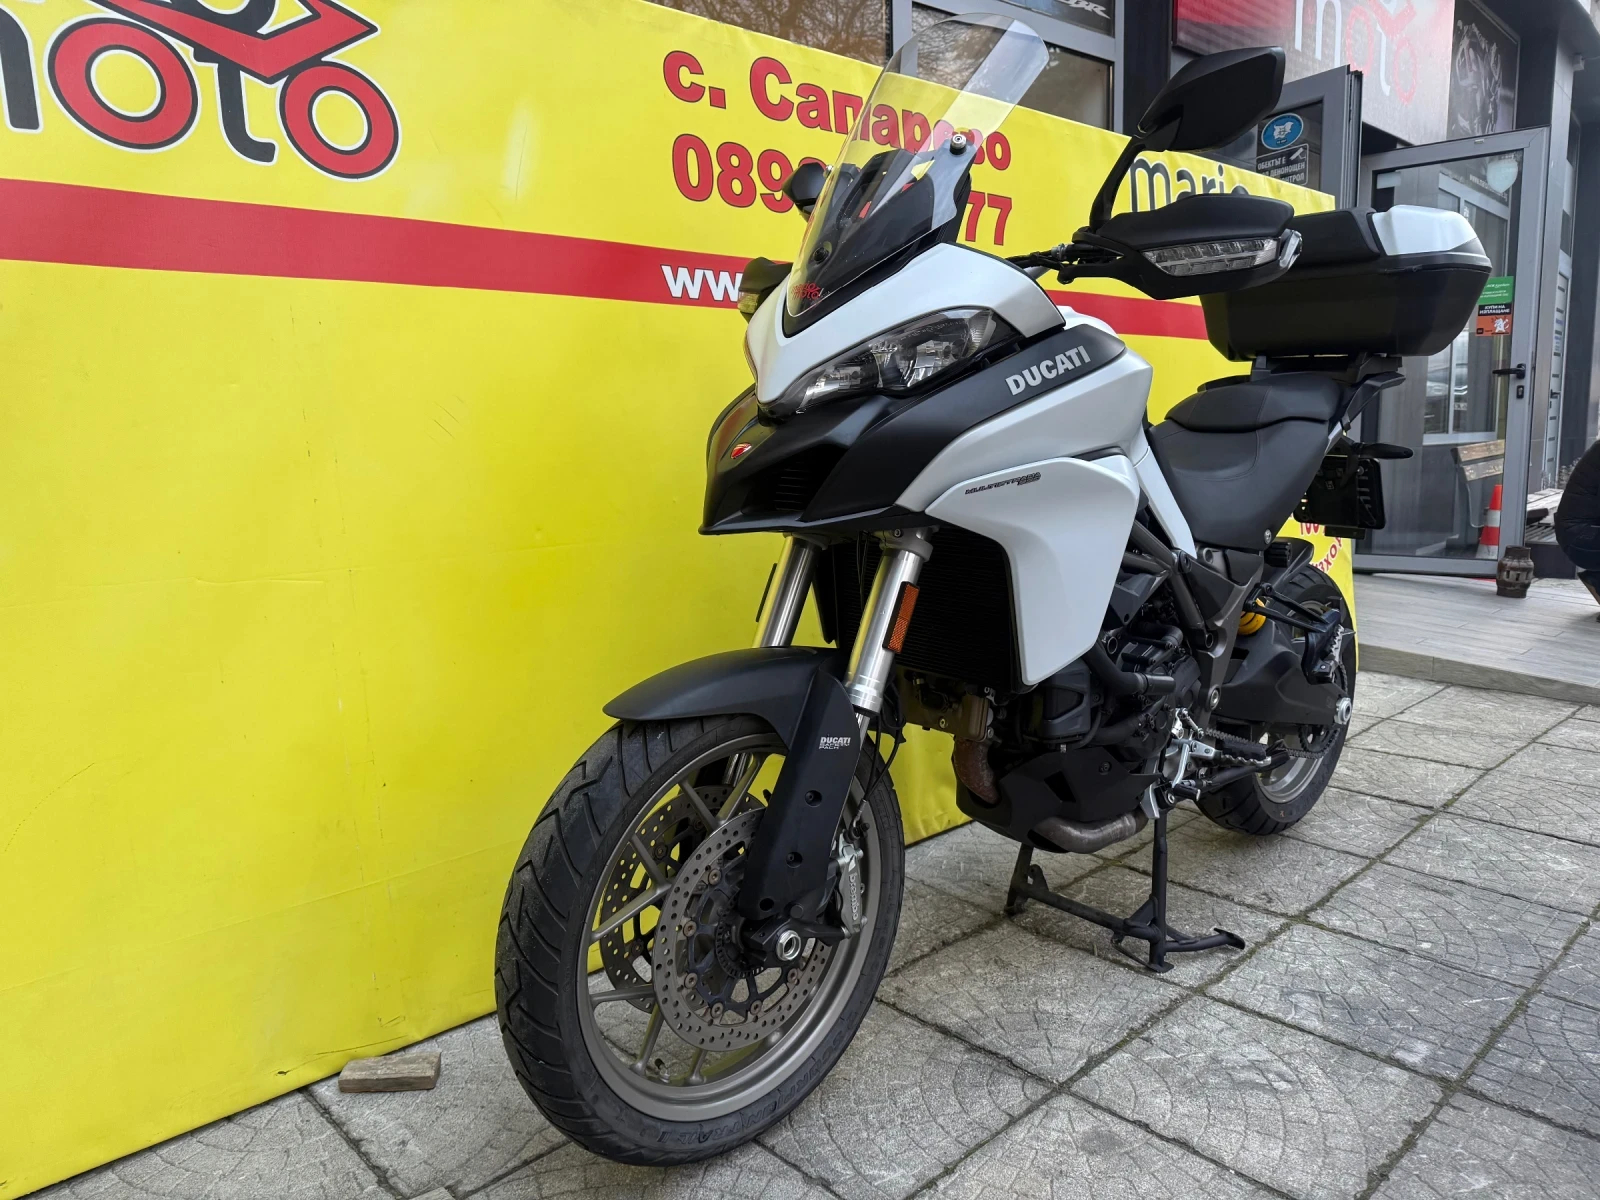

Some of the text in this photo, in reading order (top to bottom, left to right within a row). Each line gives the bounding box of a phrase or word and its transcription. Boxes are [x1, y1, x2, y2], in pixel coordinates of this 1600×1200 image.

[1005, 345, 1091, 395] DUCATI
[820, 736, 851, 744] DUCATI
[849, 872, 859, 921] brembo
